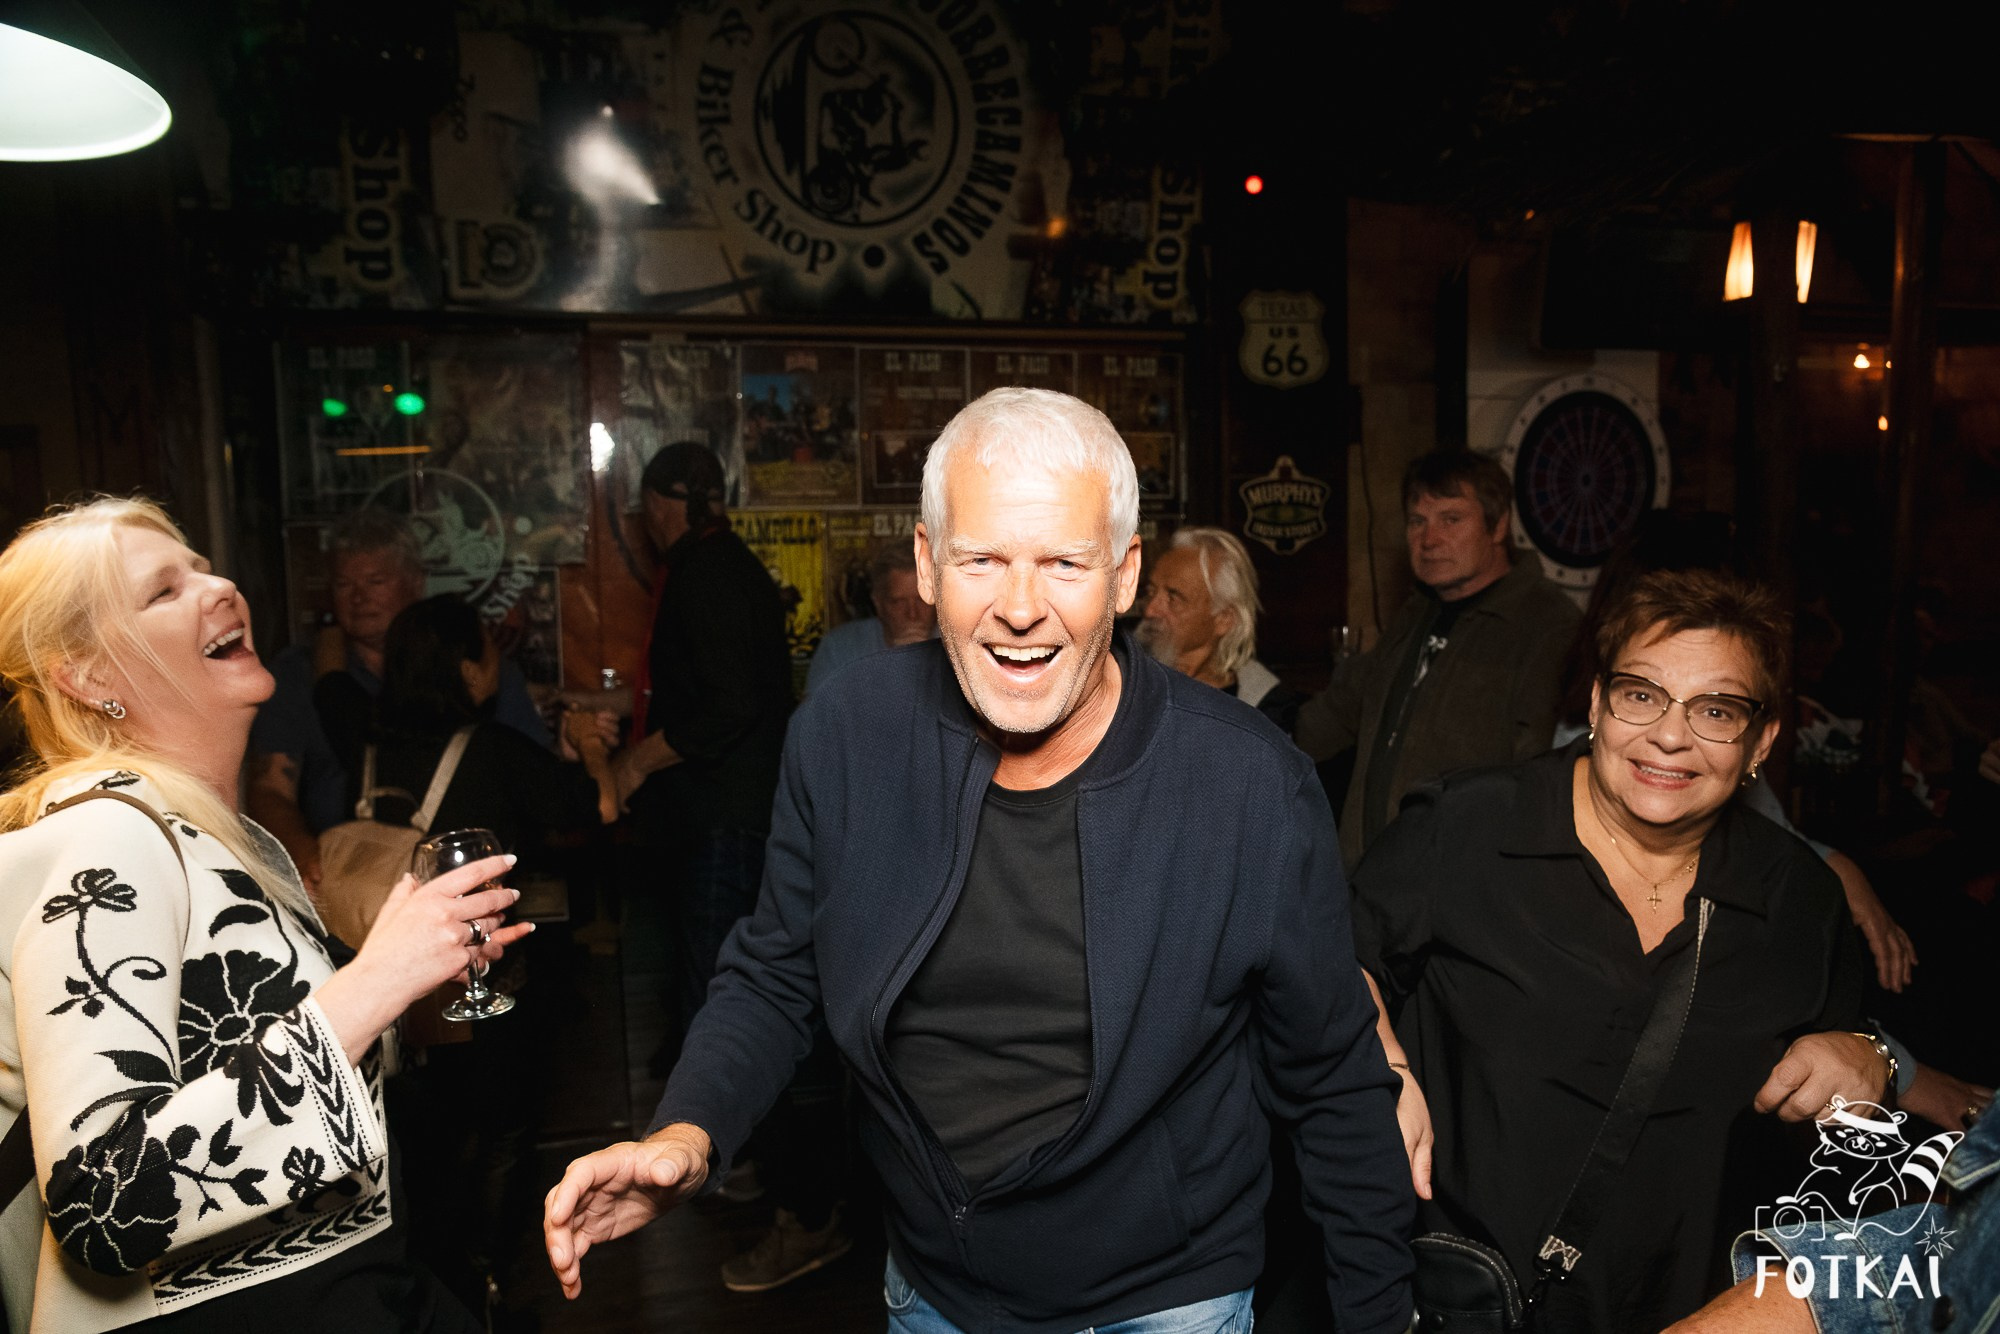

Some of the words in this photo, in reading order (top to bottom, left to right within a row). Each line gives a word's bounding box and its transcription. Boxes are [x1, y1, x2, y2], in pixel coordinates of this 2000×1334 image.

[345, 122, 400, 281] Shop
[697, 62, 740, 185] Biker
[735, 188, 836, 273] Shop
[1143, 166, 1194, 300] Shop
[1262, 342, 1309, 376] 66
